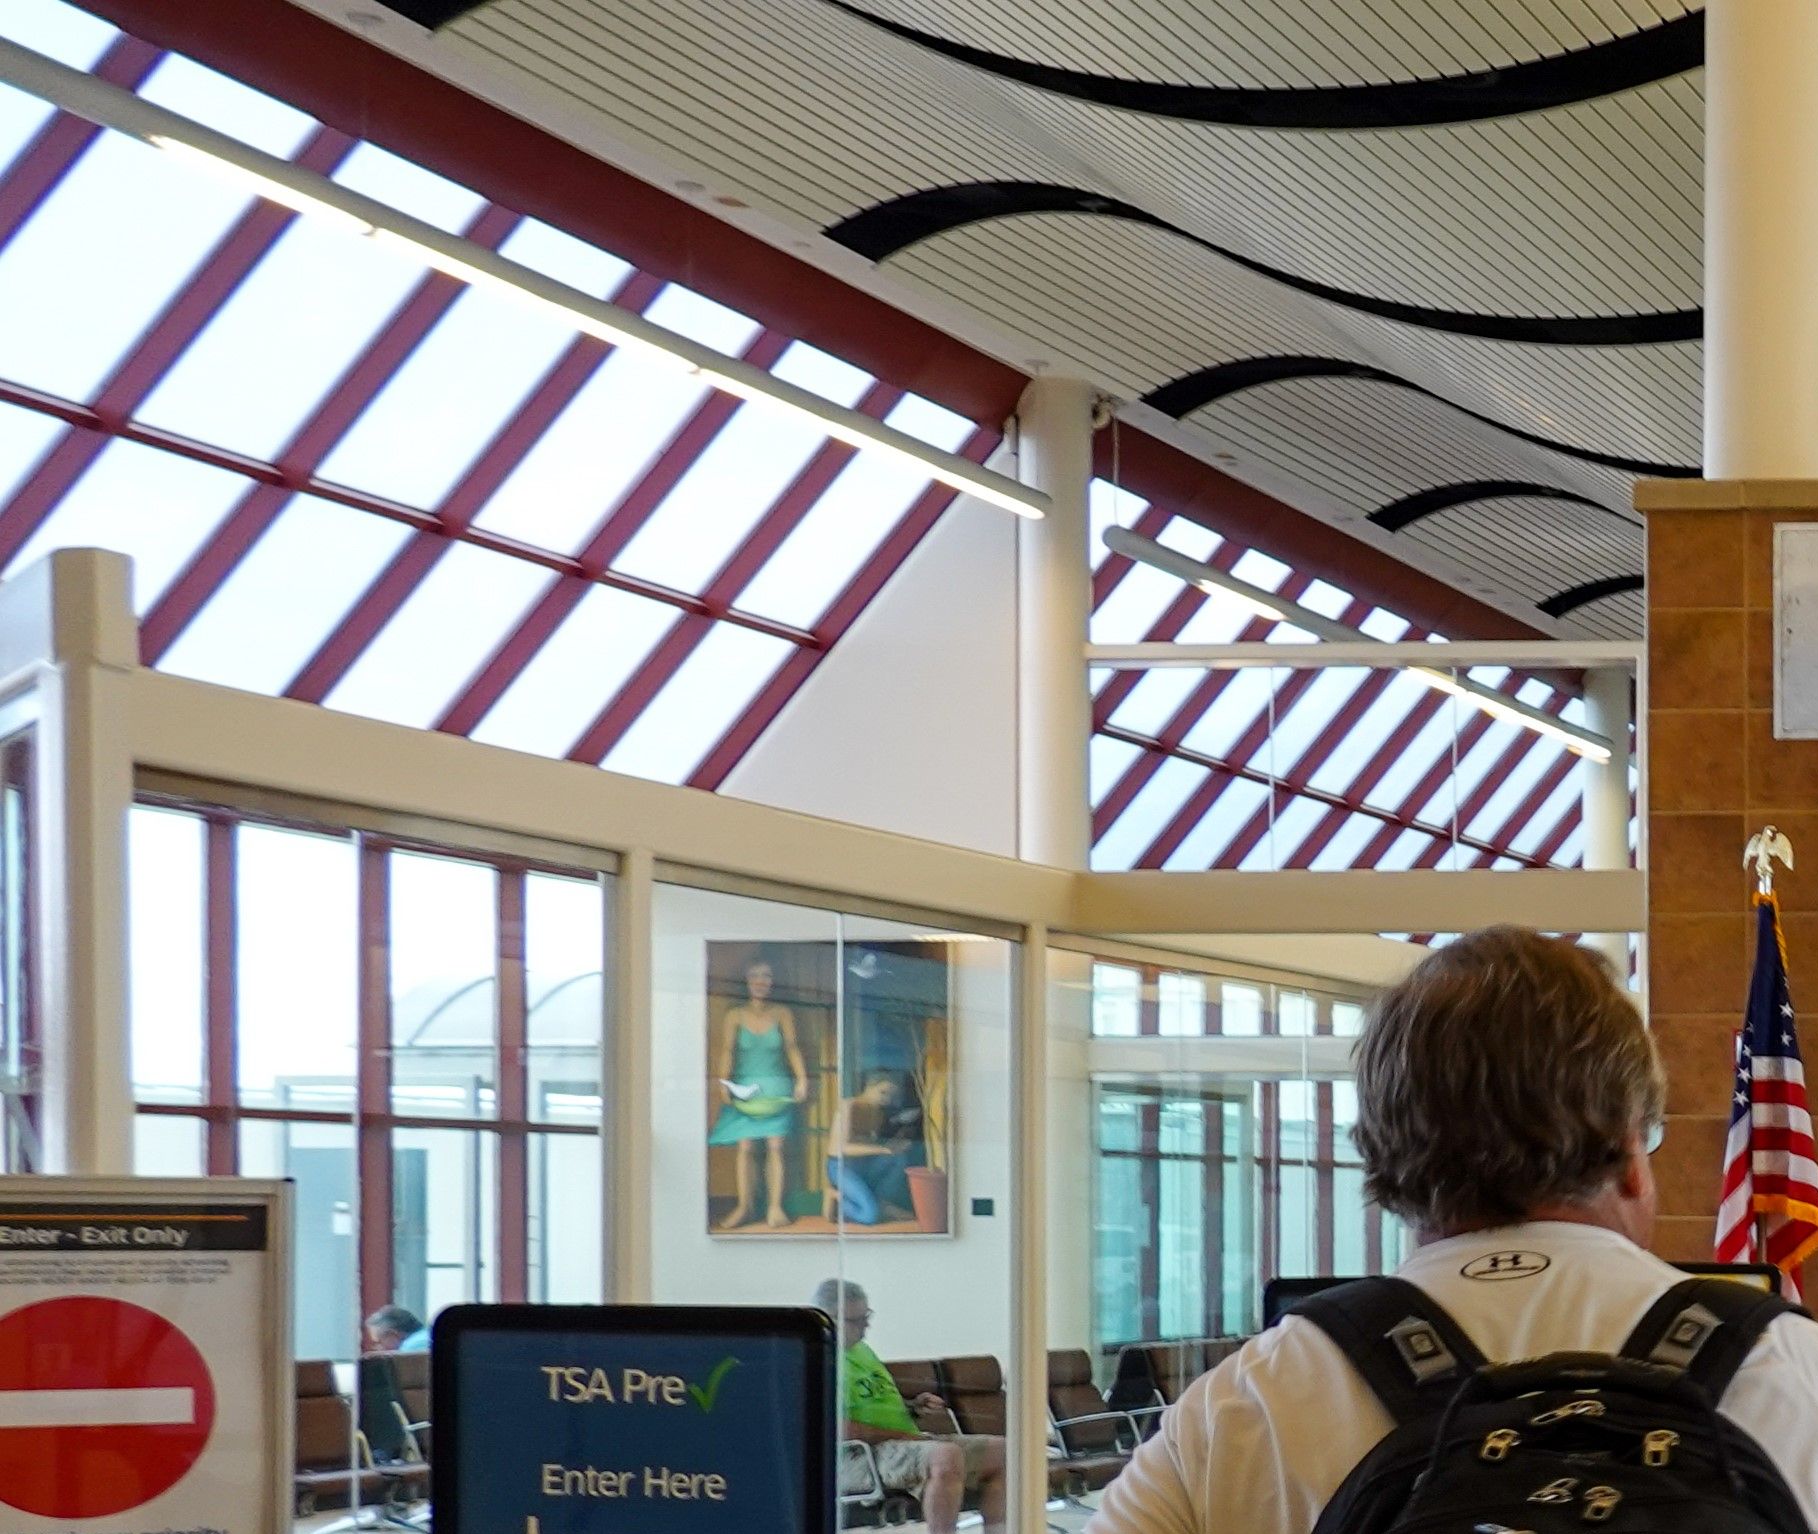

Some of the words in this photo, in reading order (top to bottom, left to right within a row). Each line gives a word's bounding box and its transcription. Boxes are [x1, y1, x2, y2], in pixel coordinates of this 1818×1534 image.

[0, 1226, 60, 1245] Enter
[80, 1226, 130, 1244] Exit
[133, 1226, 191, 1247] Only
[541, 1365, 613, 1403] TSA
[623, 1368, 687, 1406] Pre
[541, 1463, 634, 1498] Enter
[644, 1466, 727, 1501] Here
